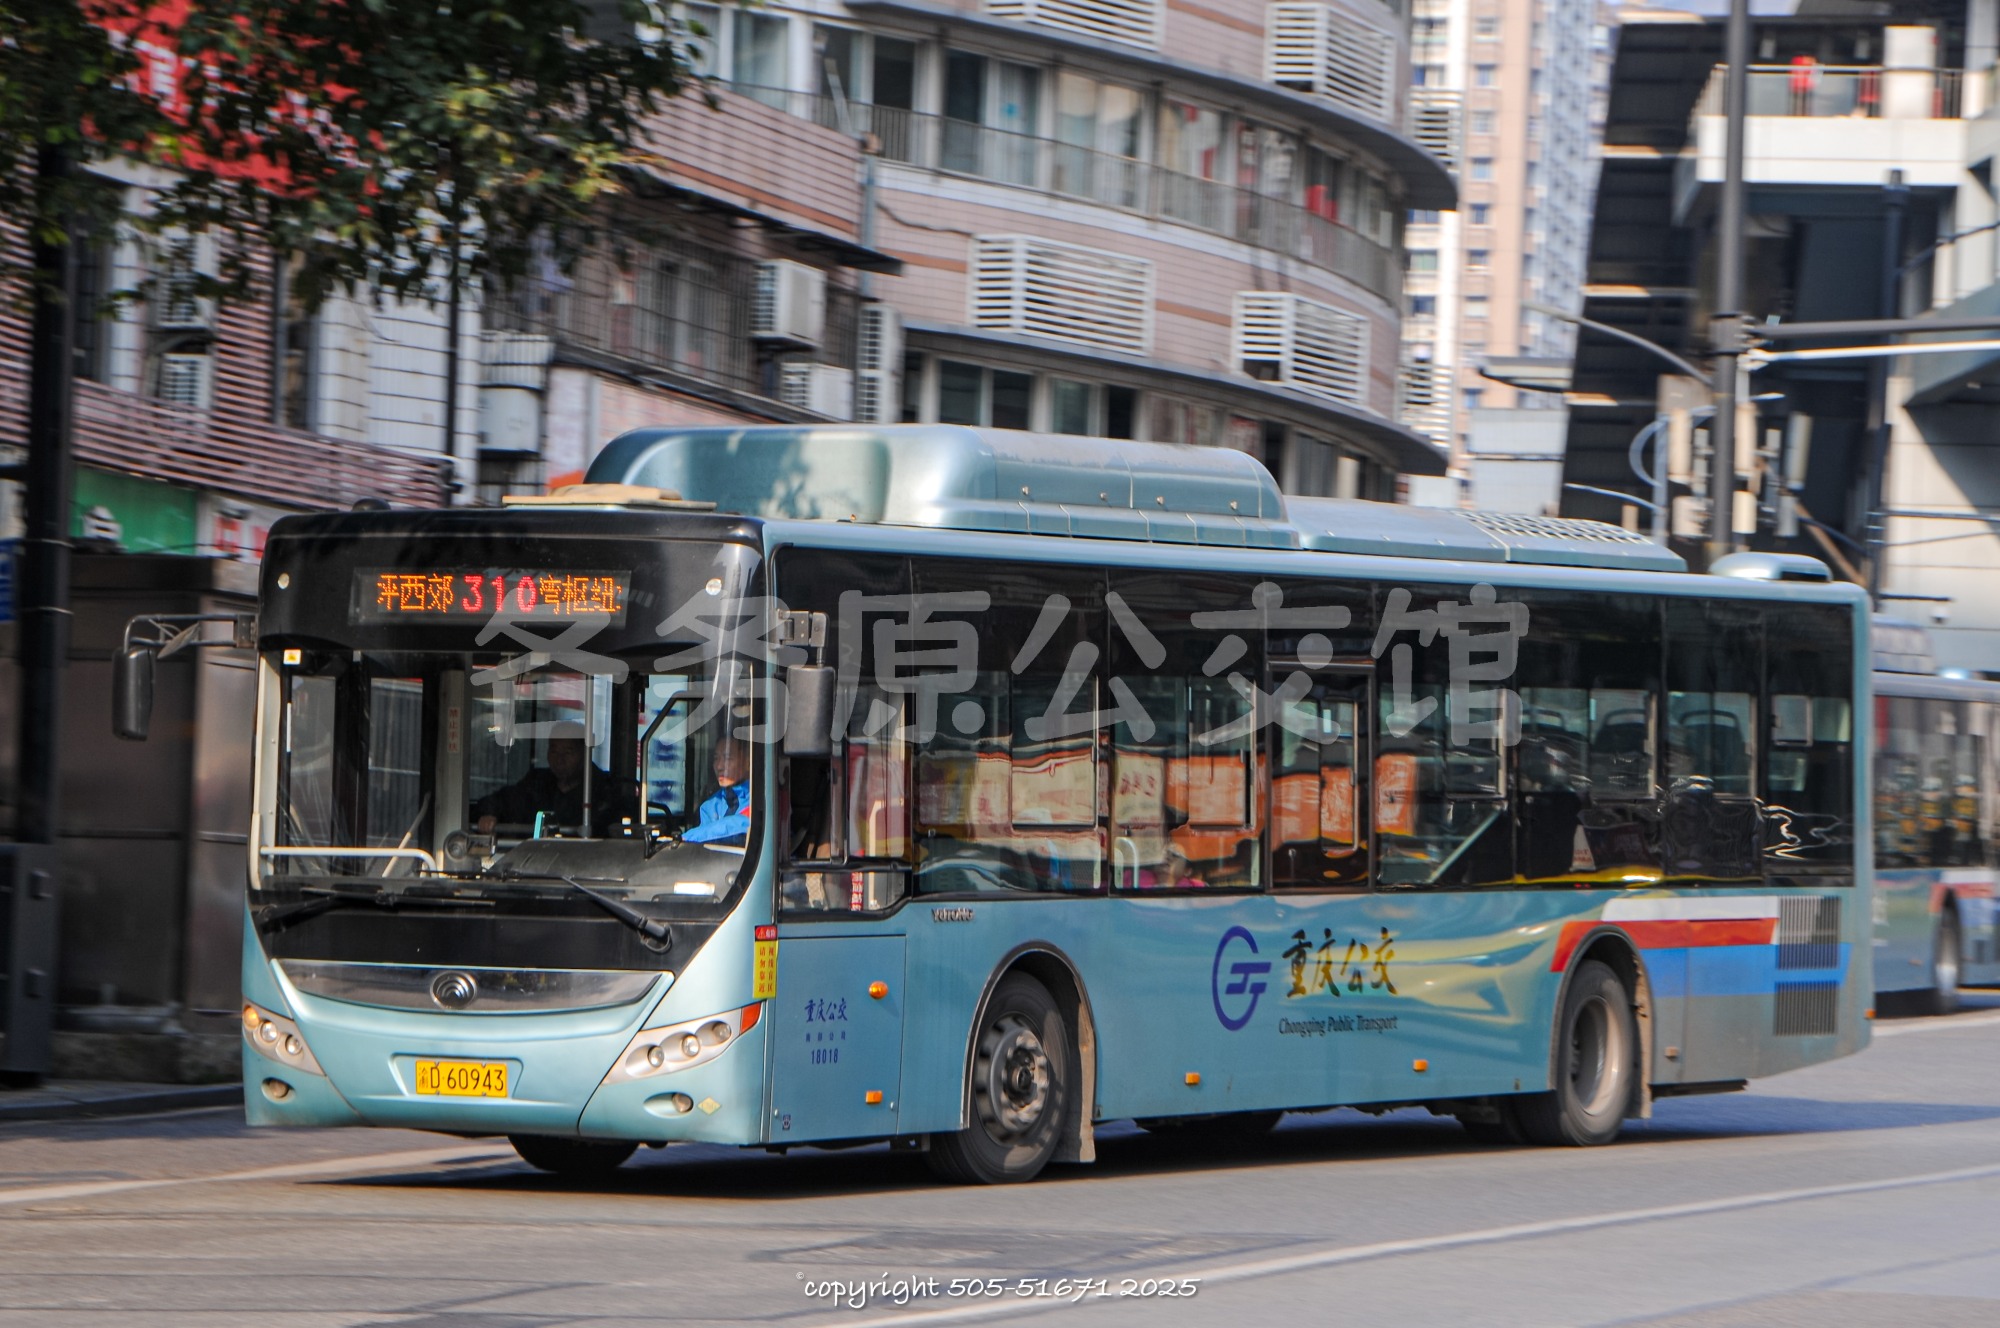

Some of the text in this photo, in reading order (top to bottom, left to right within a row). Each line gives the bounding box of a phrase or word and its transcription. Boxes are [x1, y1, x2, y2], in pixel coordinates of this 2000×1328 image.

[462, 574, 537, 612] 310
[931, 907, 975, 923] YUTONG
[1282, 926, 1398, 998] 重庆公交
[804, 997, 848, 1023] 重庆公交
[1279, 1014, 1398, 1038] Chongqing Public Transport
[811, 1048, 839, 1064] 18018
